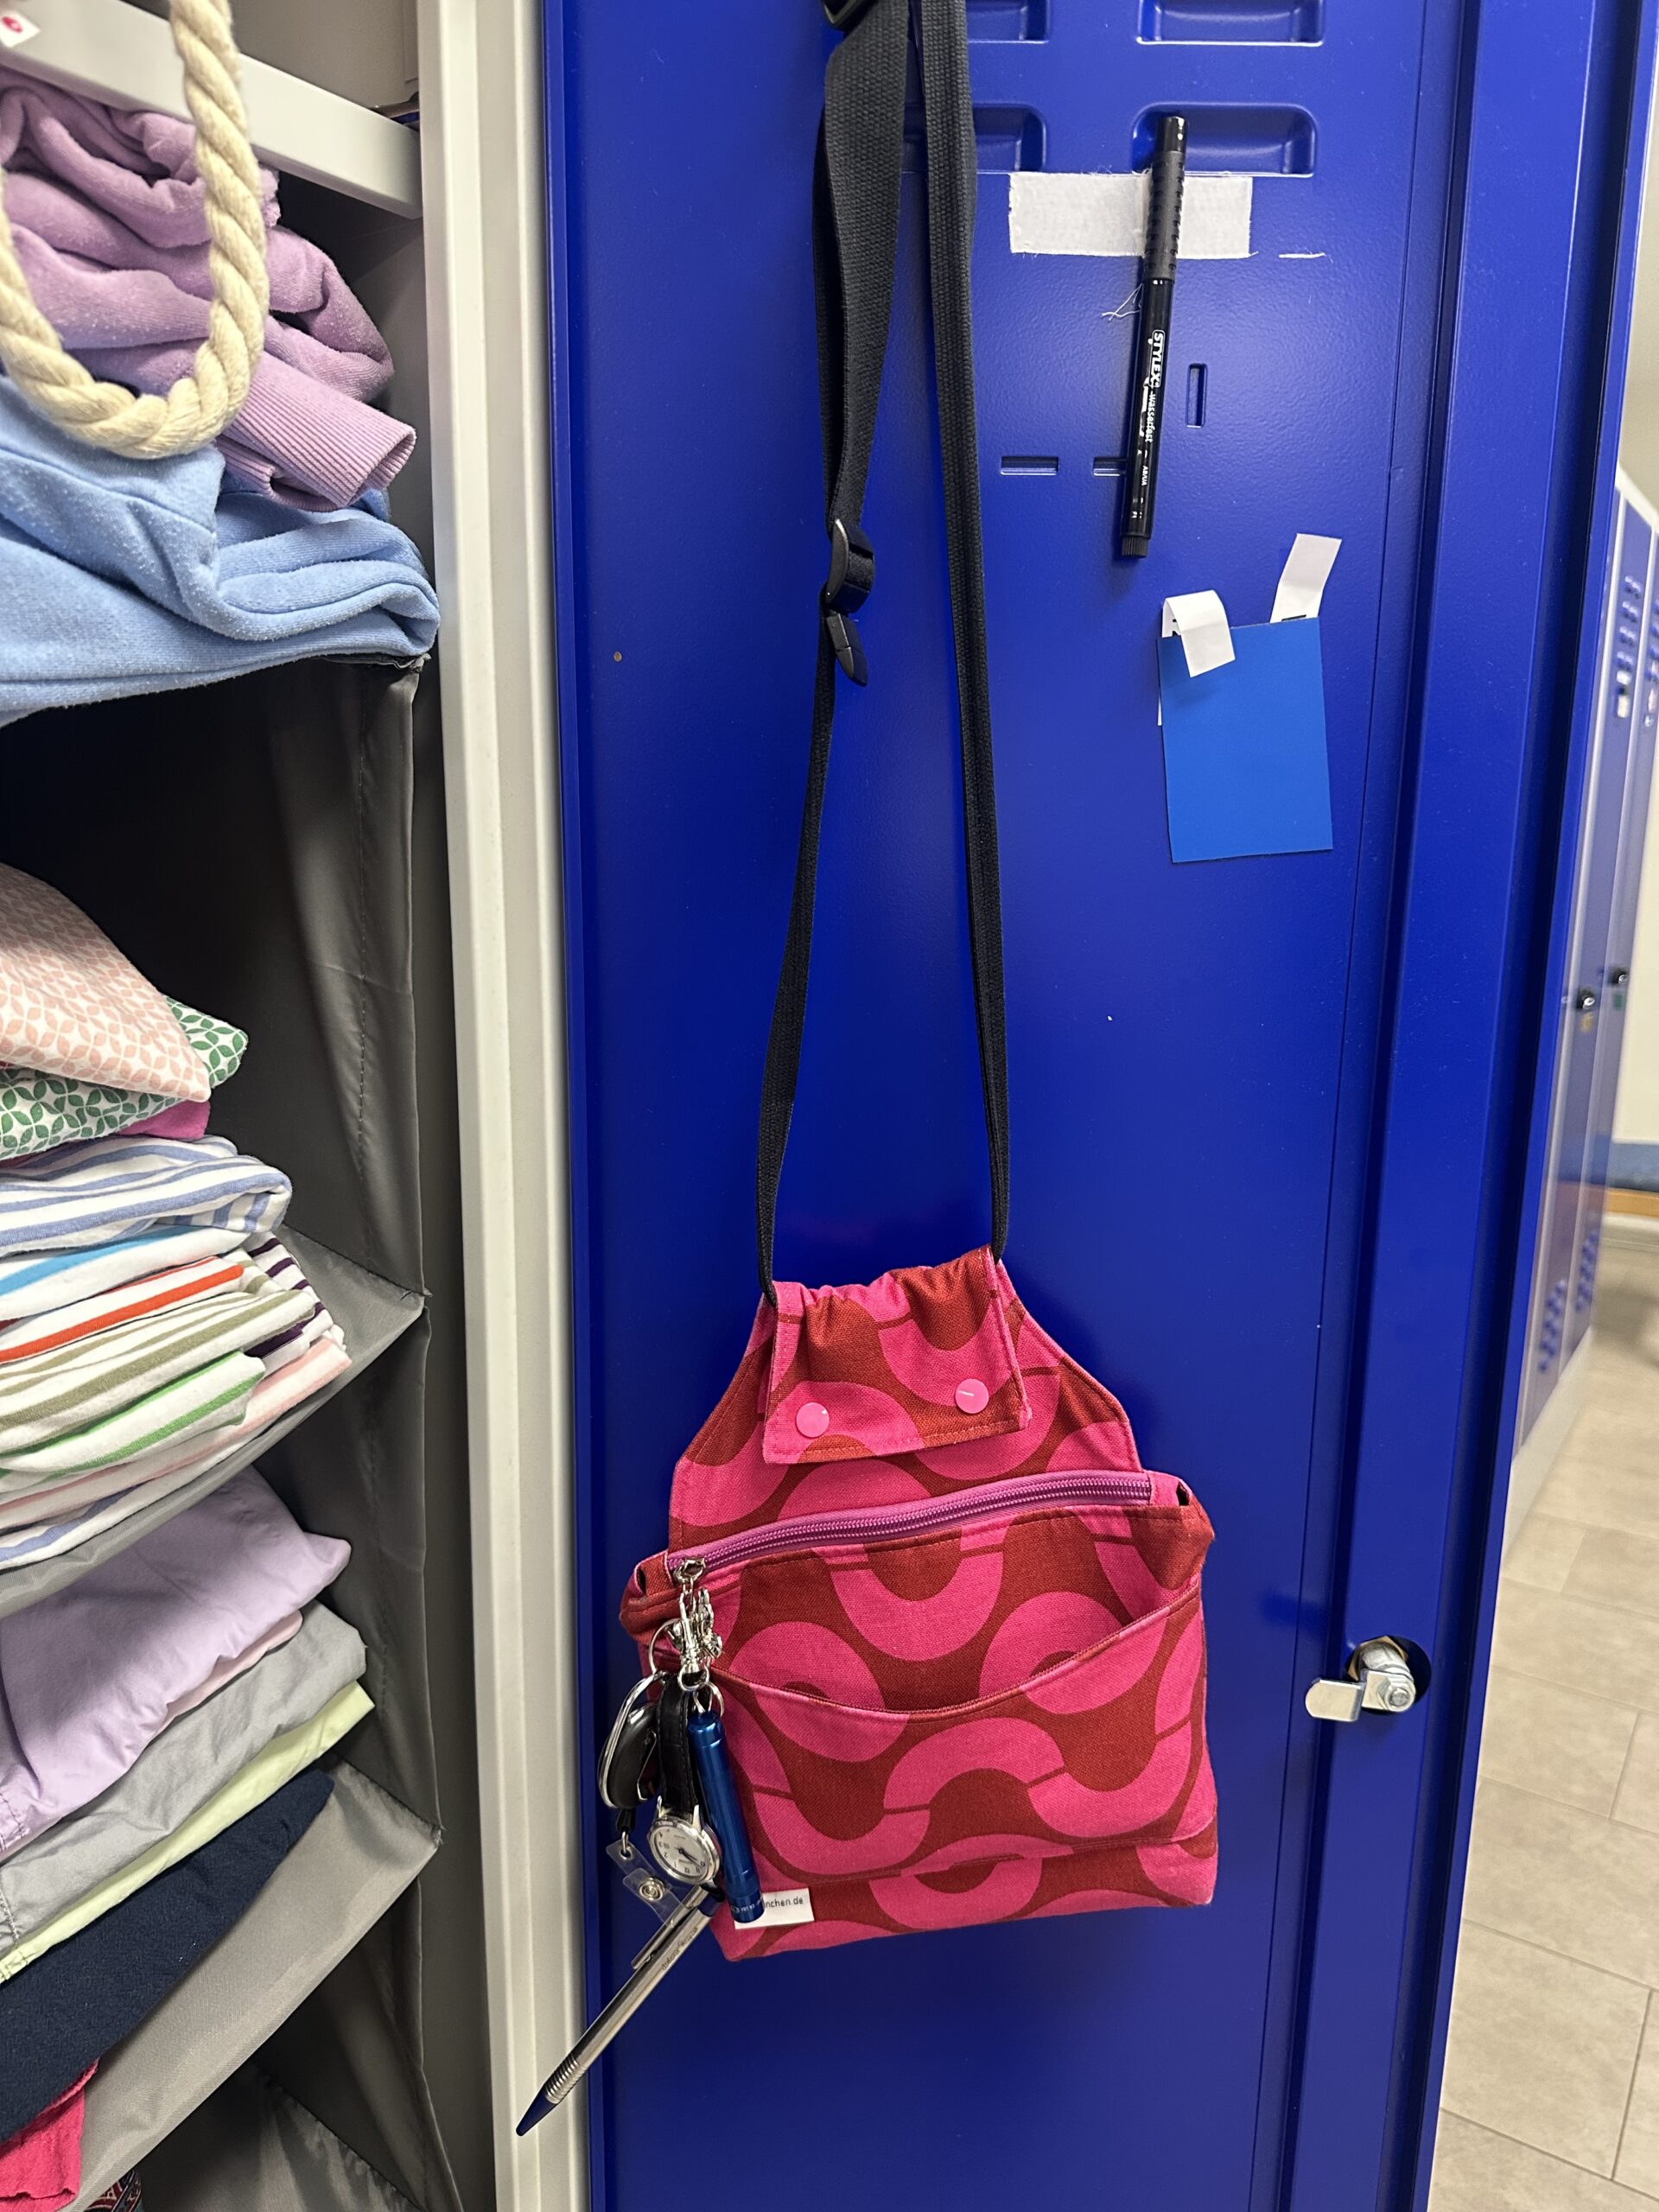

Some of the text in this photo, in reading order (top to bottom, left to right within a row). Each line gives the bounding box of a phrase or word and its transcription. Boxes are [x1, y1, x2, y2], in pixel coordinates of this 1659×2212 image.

[1150, 332, 1163, 384] STYLEX
[1145, 393, 1156, 443] wasserfest
[764, 1896, 804, 1909] nchen.de
